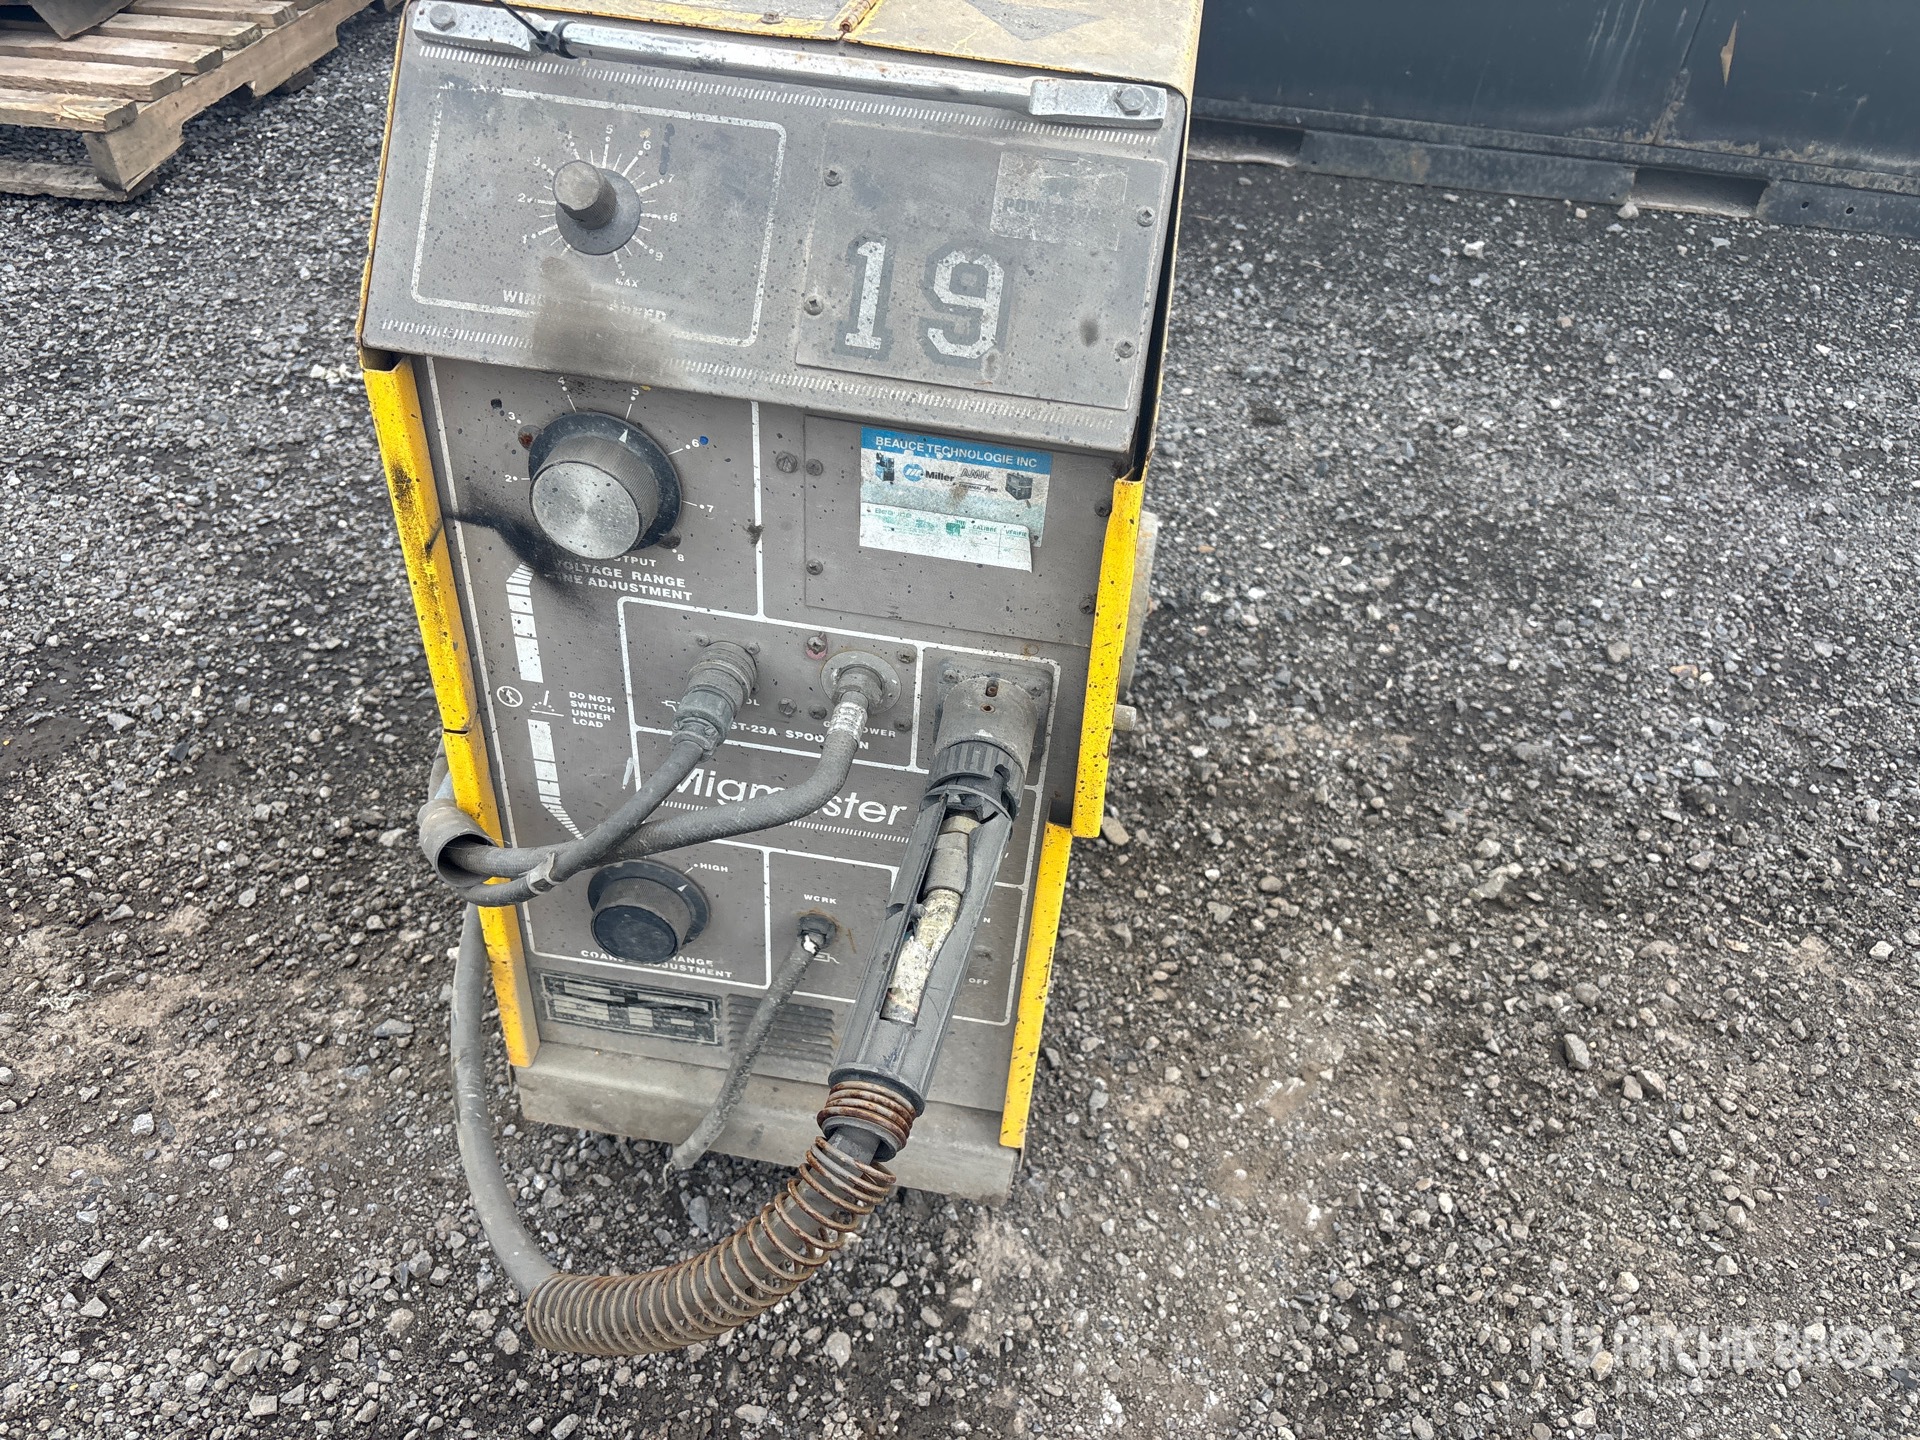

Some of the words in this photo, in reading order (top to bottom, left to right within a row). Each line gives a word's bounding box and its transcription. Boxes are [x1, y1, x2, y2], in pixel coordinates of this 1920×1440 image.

[605, 124, 614, 135] 5
[642, 140, 652, 150] 6
[533, 156, 541, 167] 3
[668, 174, 675, 183] 7
[517, 192, 526, 203] 2
[669, 212, 678, 223] 8
[522, 234, 528, 245] 1
[654, 251, 664, 262] 9
[631, 387, 640, 396] 5
[508, 412, 516, 421] 3
[692, 438, 700, 448] 6
[875, 436, 925, 452] BEAUCE
[927, 443, 1013, 465] TECHNOLOGIE
[1016, 457, 1037, 469] INC
[504, 474, 513, 483] 2
[925, 470, 955, 482] Miller
[706, 504, 714, 513] 7
[677, 554, 685, 562] 8
[631, 571, 686, 588] RANGE
[588, 576, 693, 601] ADJUSTMENT
[569, 691, 585, 700] DO
[588, 694, 613, 704] NOT
[570, 700, 616, 713] SWITCH
[571, 709, 611, 721] UNDER
[572, 717, 604, 728] LOAD
[785, 729, 825, 743] SPOO
[862, 726, 896, 738] OWER
[699, 862, 729, 873] HIGH
[968, 977, 990, 986] OFF
